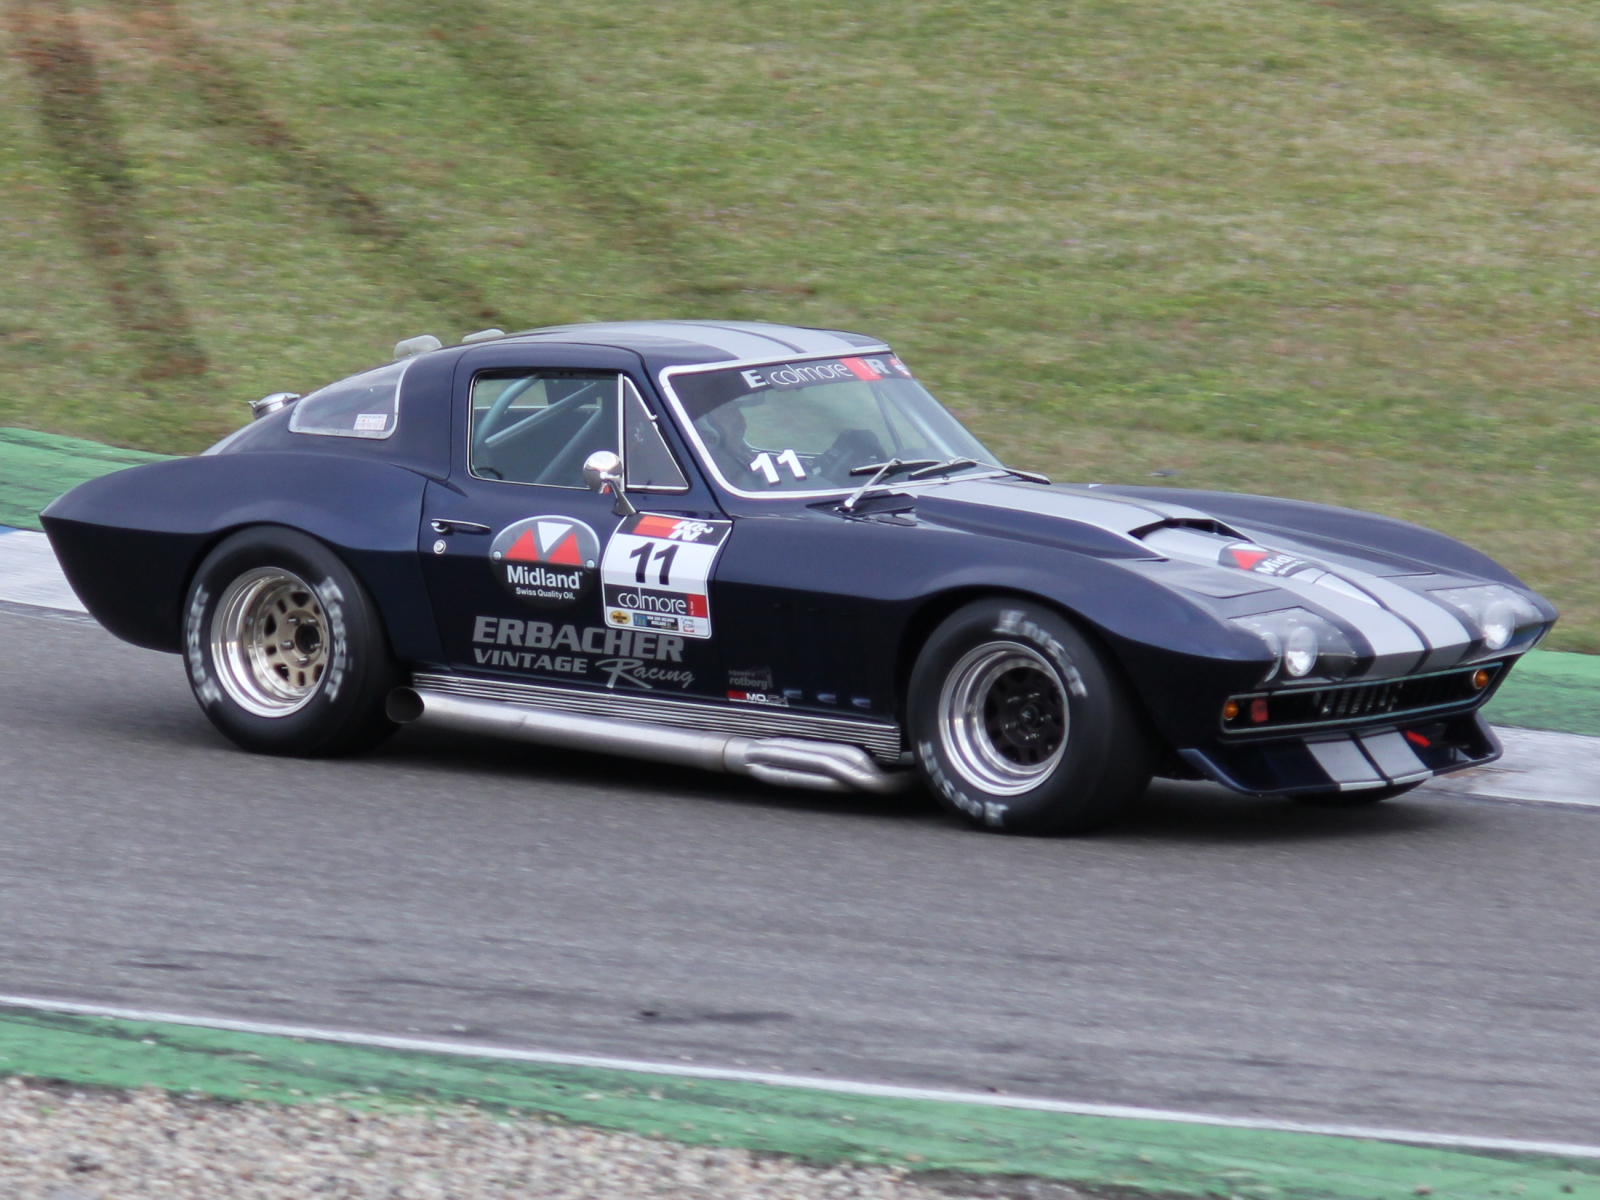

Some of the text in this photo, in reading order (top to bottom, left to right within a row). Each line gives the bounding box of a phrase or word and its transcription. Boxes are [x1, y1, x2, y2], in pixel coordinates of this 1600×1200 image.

[770, 364, 854, 386] colmore
[750, 449, 807, 485] 11
[506, 564, 581, 590] Midland
[629, 541, 680, 586] 11
[515, 586, 537, 597] Swiss
[537, 588, 563, 600] Quality
[617, 587, 688, 615] colmore
[472, 615, 685, 662] ERBACHER
[474, 648, 695, 689] VINTAGE Racing
[730, 676, 768, 690] rotberg
